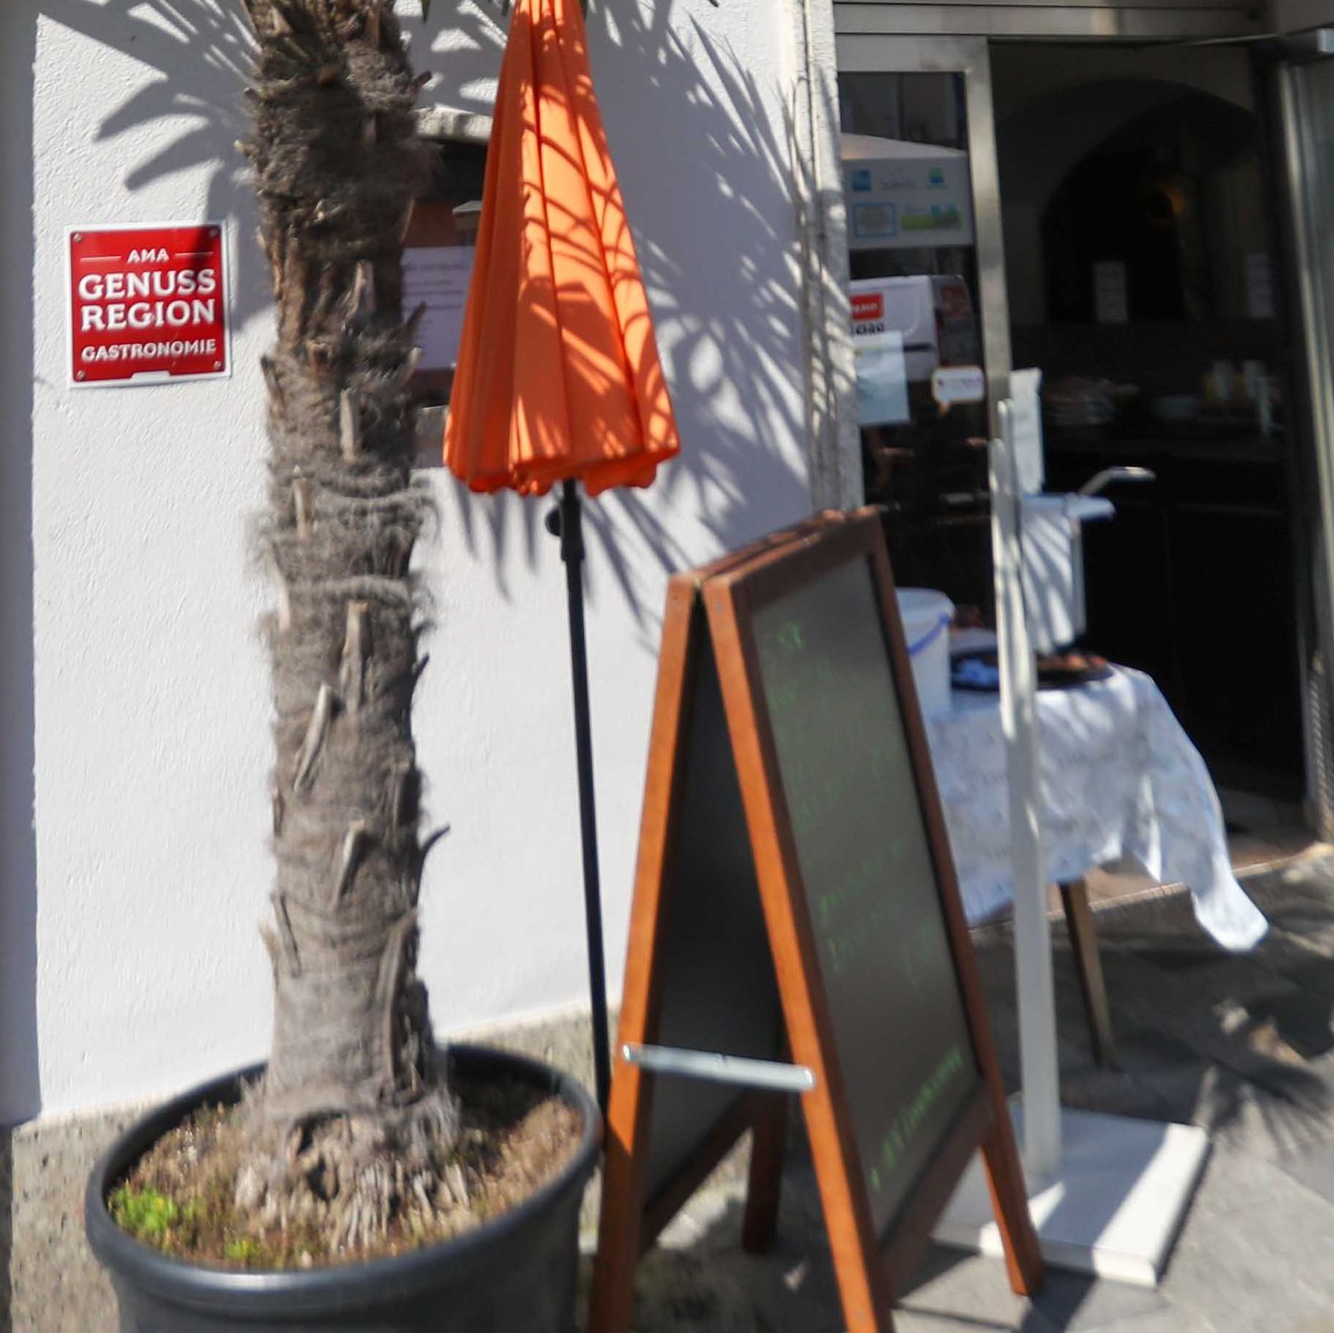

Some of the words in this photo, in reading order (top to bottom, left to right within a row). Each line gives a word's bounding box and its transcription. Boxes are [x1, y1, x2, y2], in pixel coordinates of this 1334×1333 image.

[127, 248, 169, 264] AMA
[78, 269, 217, 301] GENUSS
[80, 298, 216, 332] REGION
[80, 338, 217, 362] GASTRONOMIE
